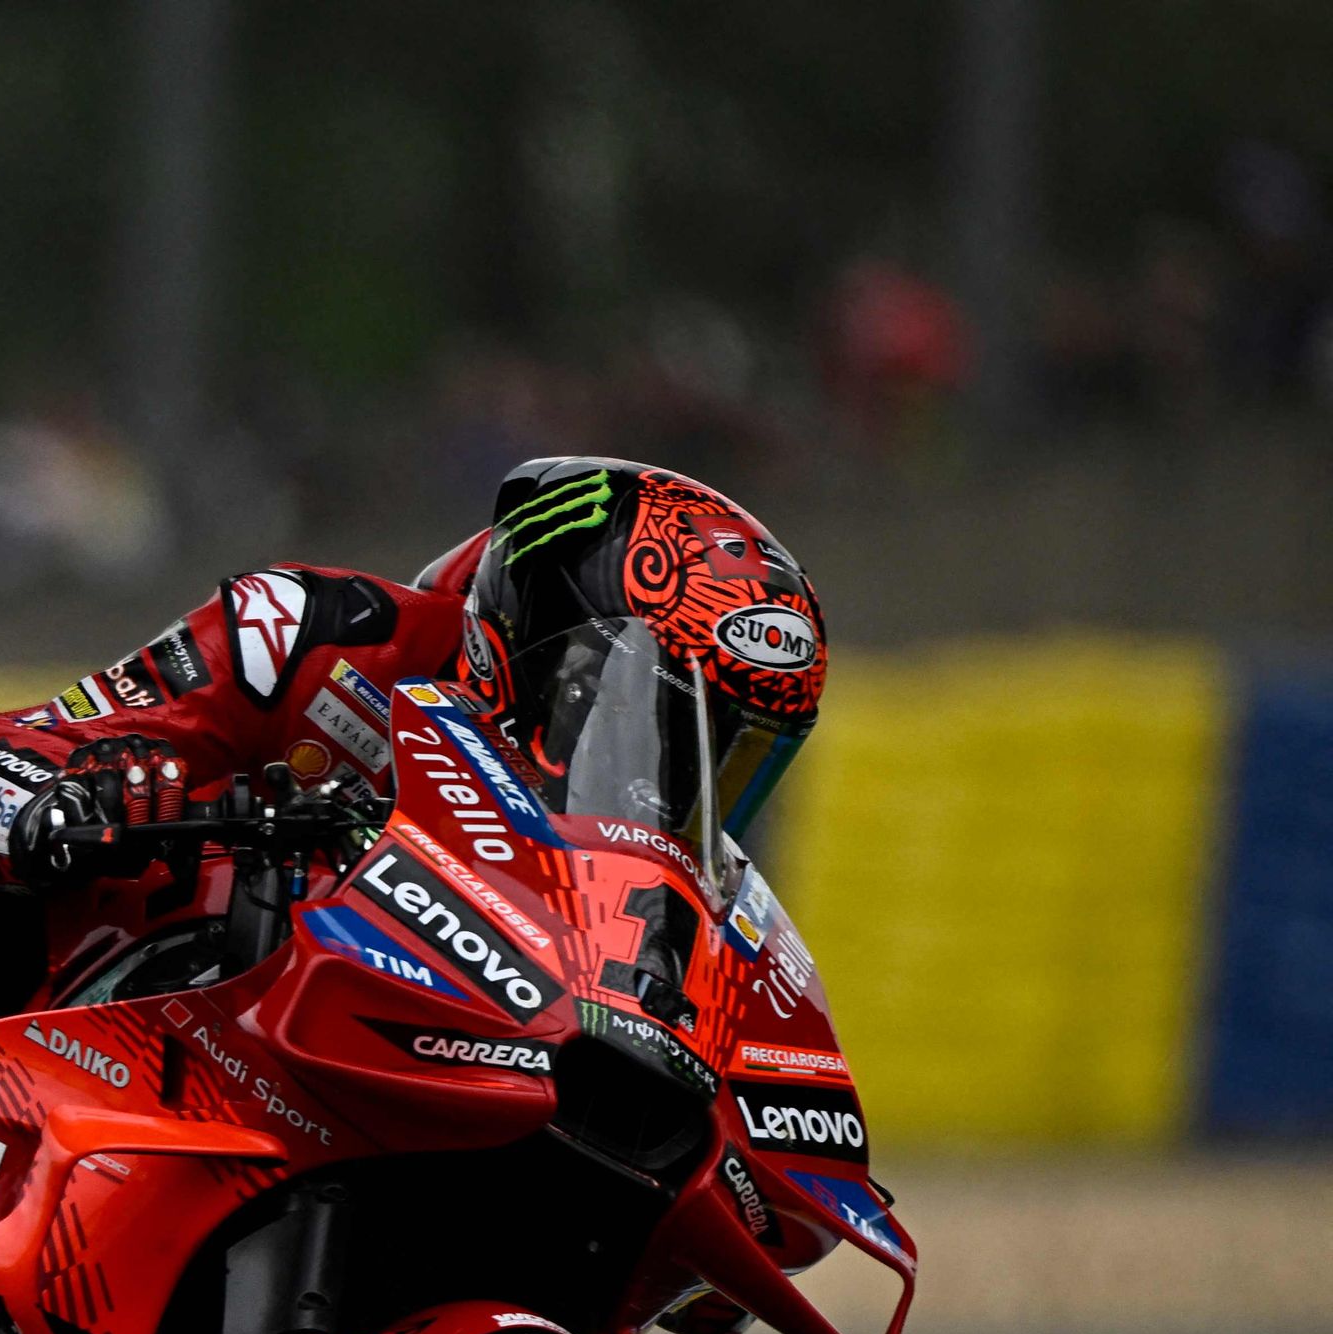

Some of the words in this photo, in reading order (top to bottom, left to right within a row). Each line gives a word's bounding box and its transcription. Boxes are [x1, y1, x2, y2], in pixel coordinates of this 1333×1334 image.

[170, 632, 199, 682] ONSTER
[733, 616, 816, 663] SUOMY
[357, 686, 392, 719] MICHE
[399, 825, 551, 949] FRECCIAROSSA
[363, 854, 543, 1009] Lenovo
[366, 948, 434, 986] TIM
[48, 1027, 131, 1088] DAIKO
[413, 1035, 552, 1072] CARRERA
[612, 1014, 717, 1095] MONSTER
[741, 1046, 848, 1073] FRECCIAROSSA
[192, 1026, 250, 1083] Audi
[251, 1077, 333, 1146] Sport
[736, 1096, 864, 1148] Lenovo
[724, 1156, 770, 1236] CARRERA
